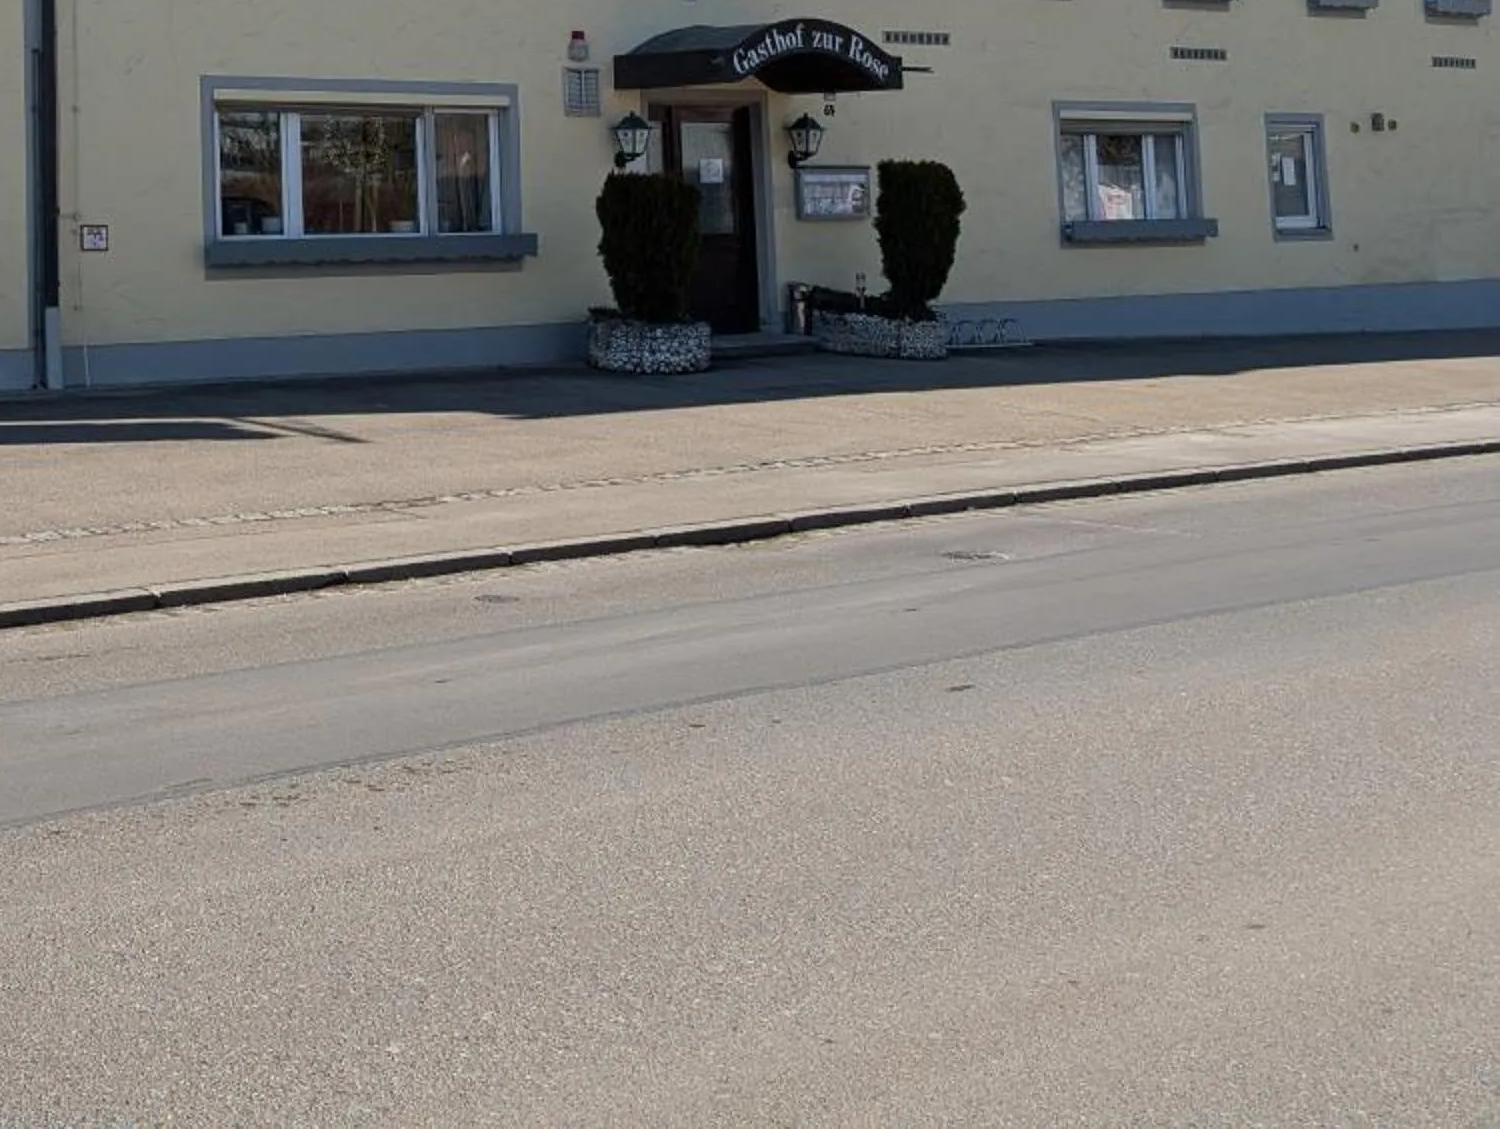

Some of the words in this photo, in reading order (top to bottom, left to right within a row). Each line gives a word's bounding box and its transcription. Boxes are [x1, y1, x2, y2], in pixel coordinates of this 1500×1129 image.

[733, 22, 804, 75] Gasthof
[811, 29, 844, 52] zur
[847, 34, 890, 79] Rose
